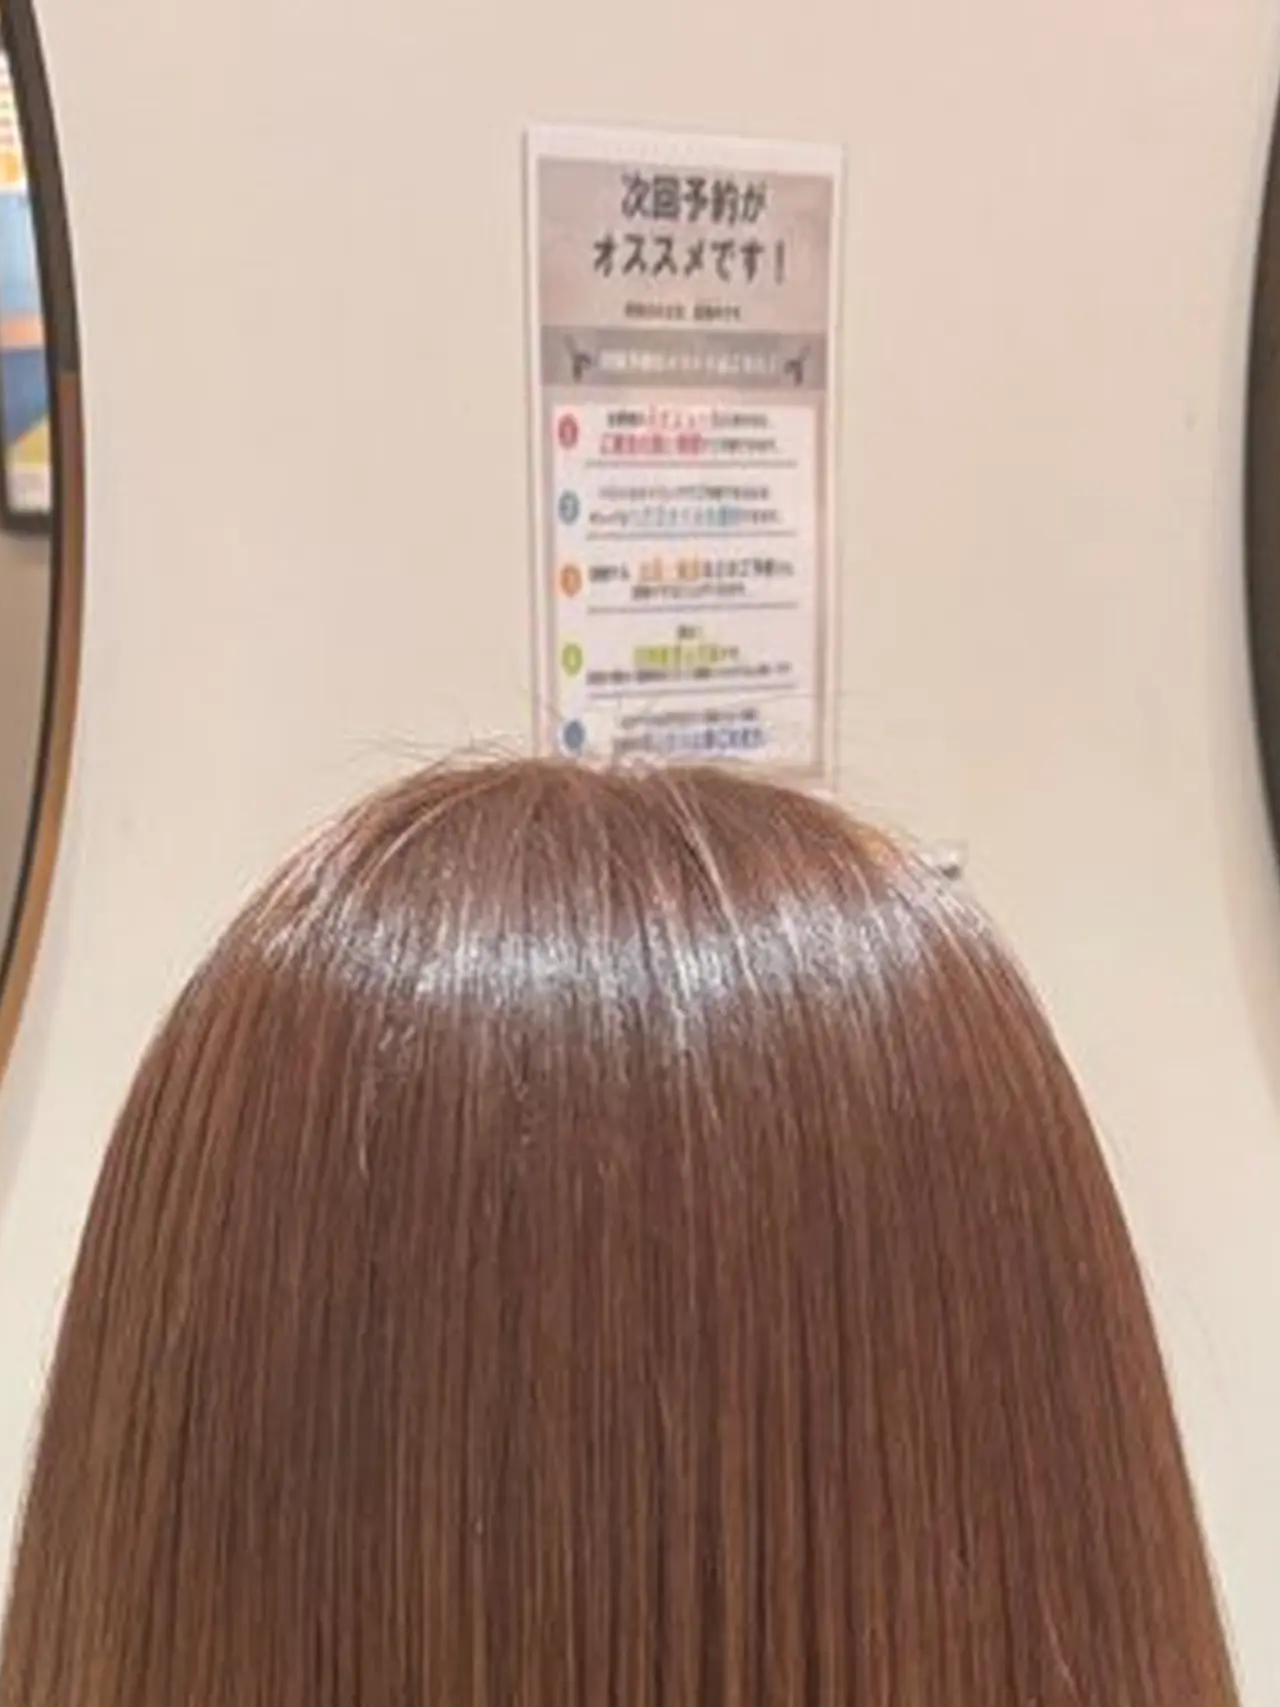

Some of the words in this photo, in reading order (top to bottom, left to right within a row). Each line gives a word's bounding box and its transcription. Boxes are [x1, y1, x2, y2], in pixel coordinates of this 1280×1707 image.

[621, 171, 767, 224] 次回予約が
